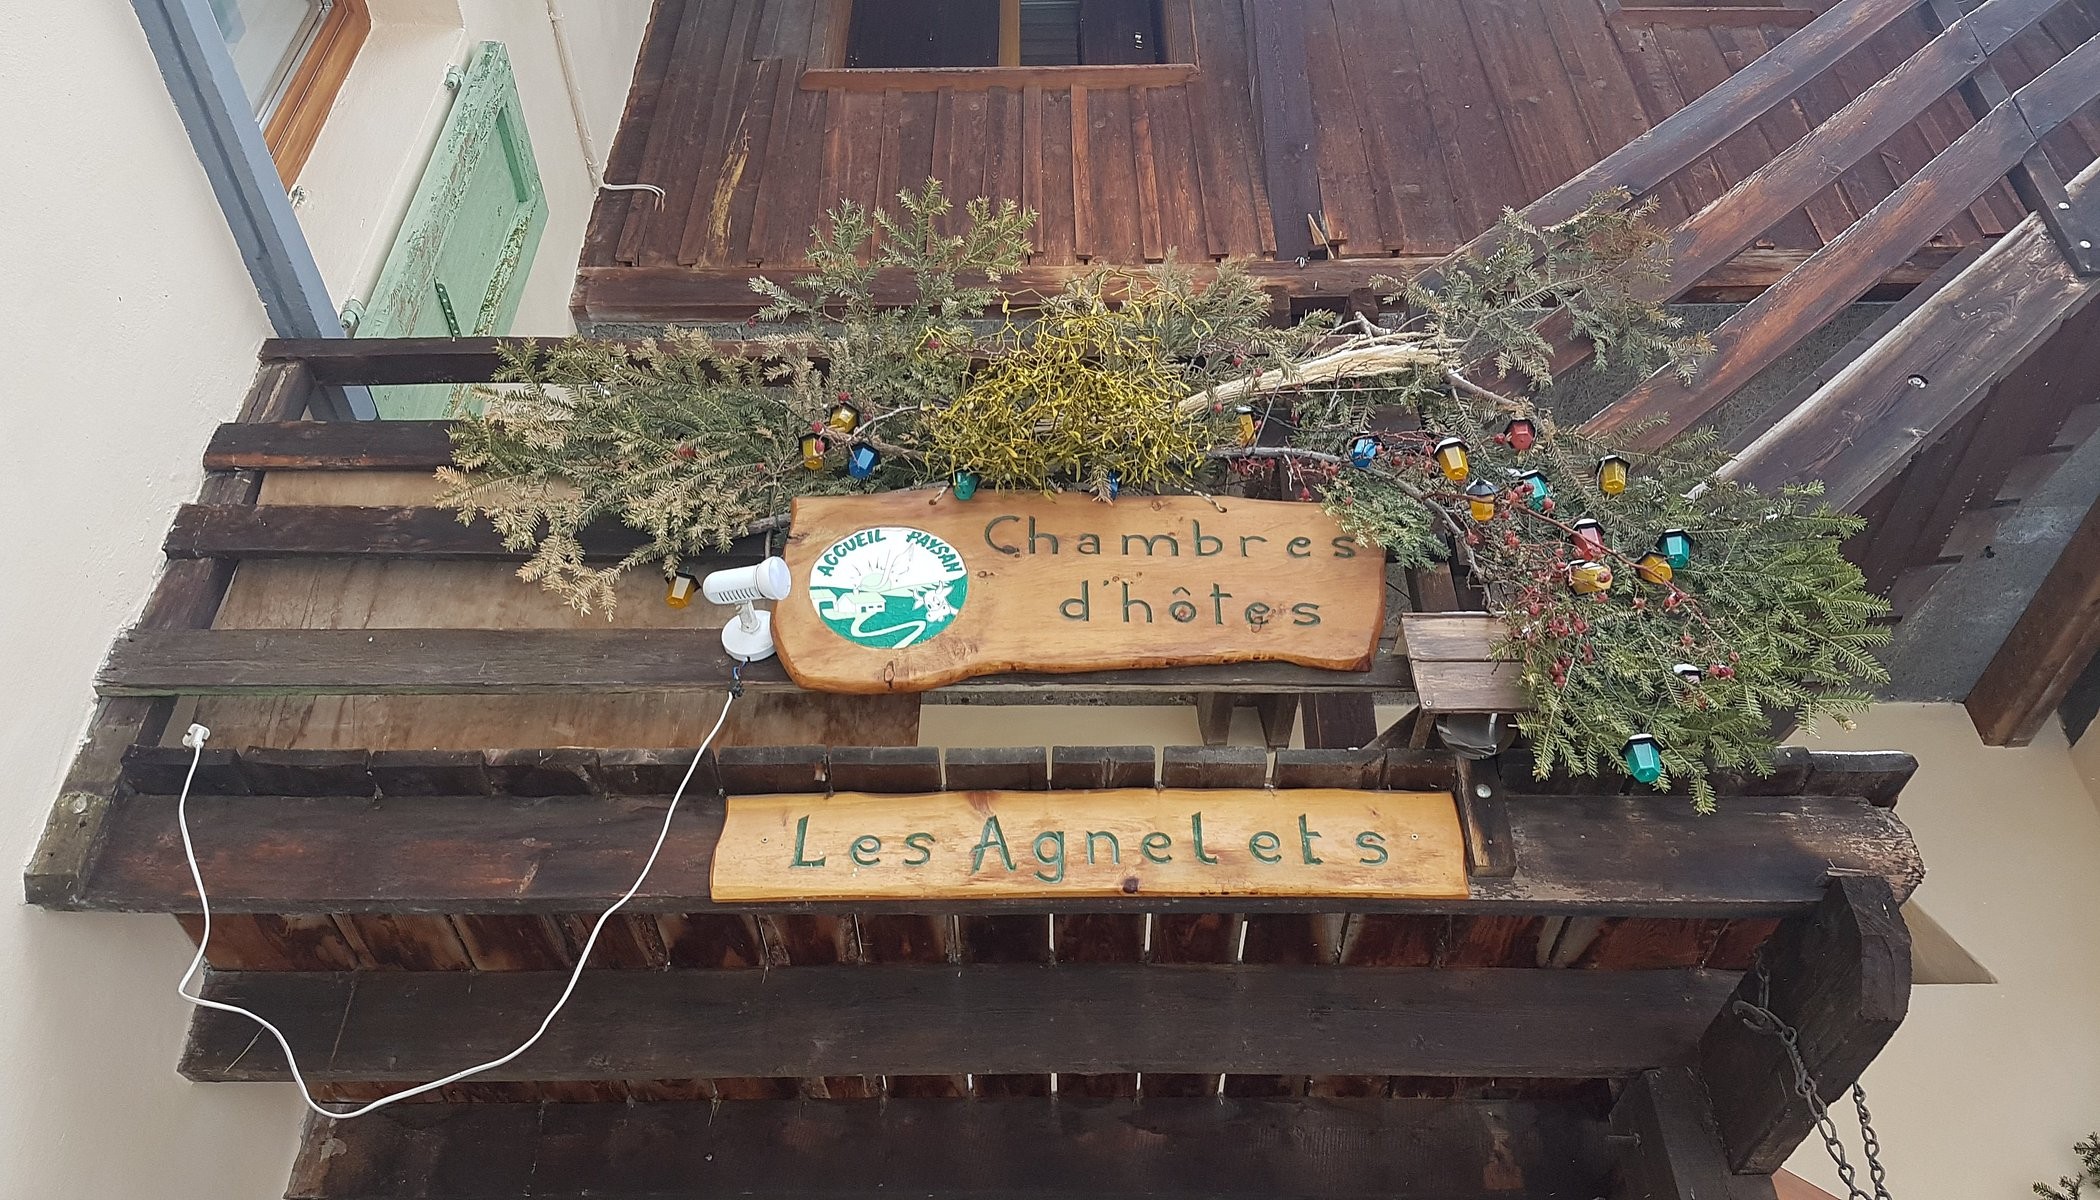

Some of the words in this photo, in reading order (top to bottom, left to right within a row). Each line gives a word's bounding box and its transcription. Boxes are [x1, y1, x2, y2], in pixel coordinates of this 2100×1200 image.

[817, 529, 886, 576] ACCUEIL
[906, 531, 963, 573] PAYSAN
[984, 515, 1357, 558] Chambres
[1059, 580, 1321, 626] d'hôtes
[788, 814, 936, 869] Les
[969, 810, 1389, 883] Agnelets
